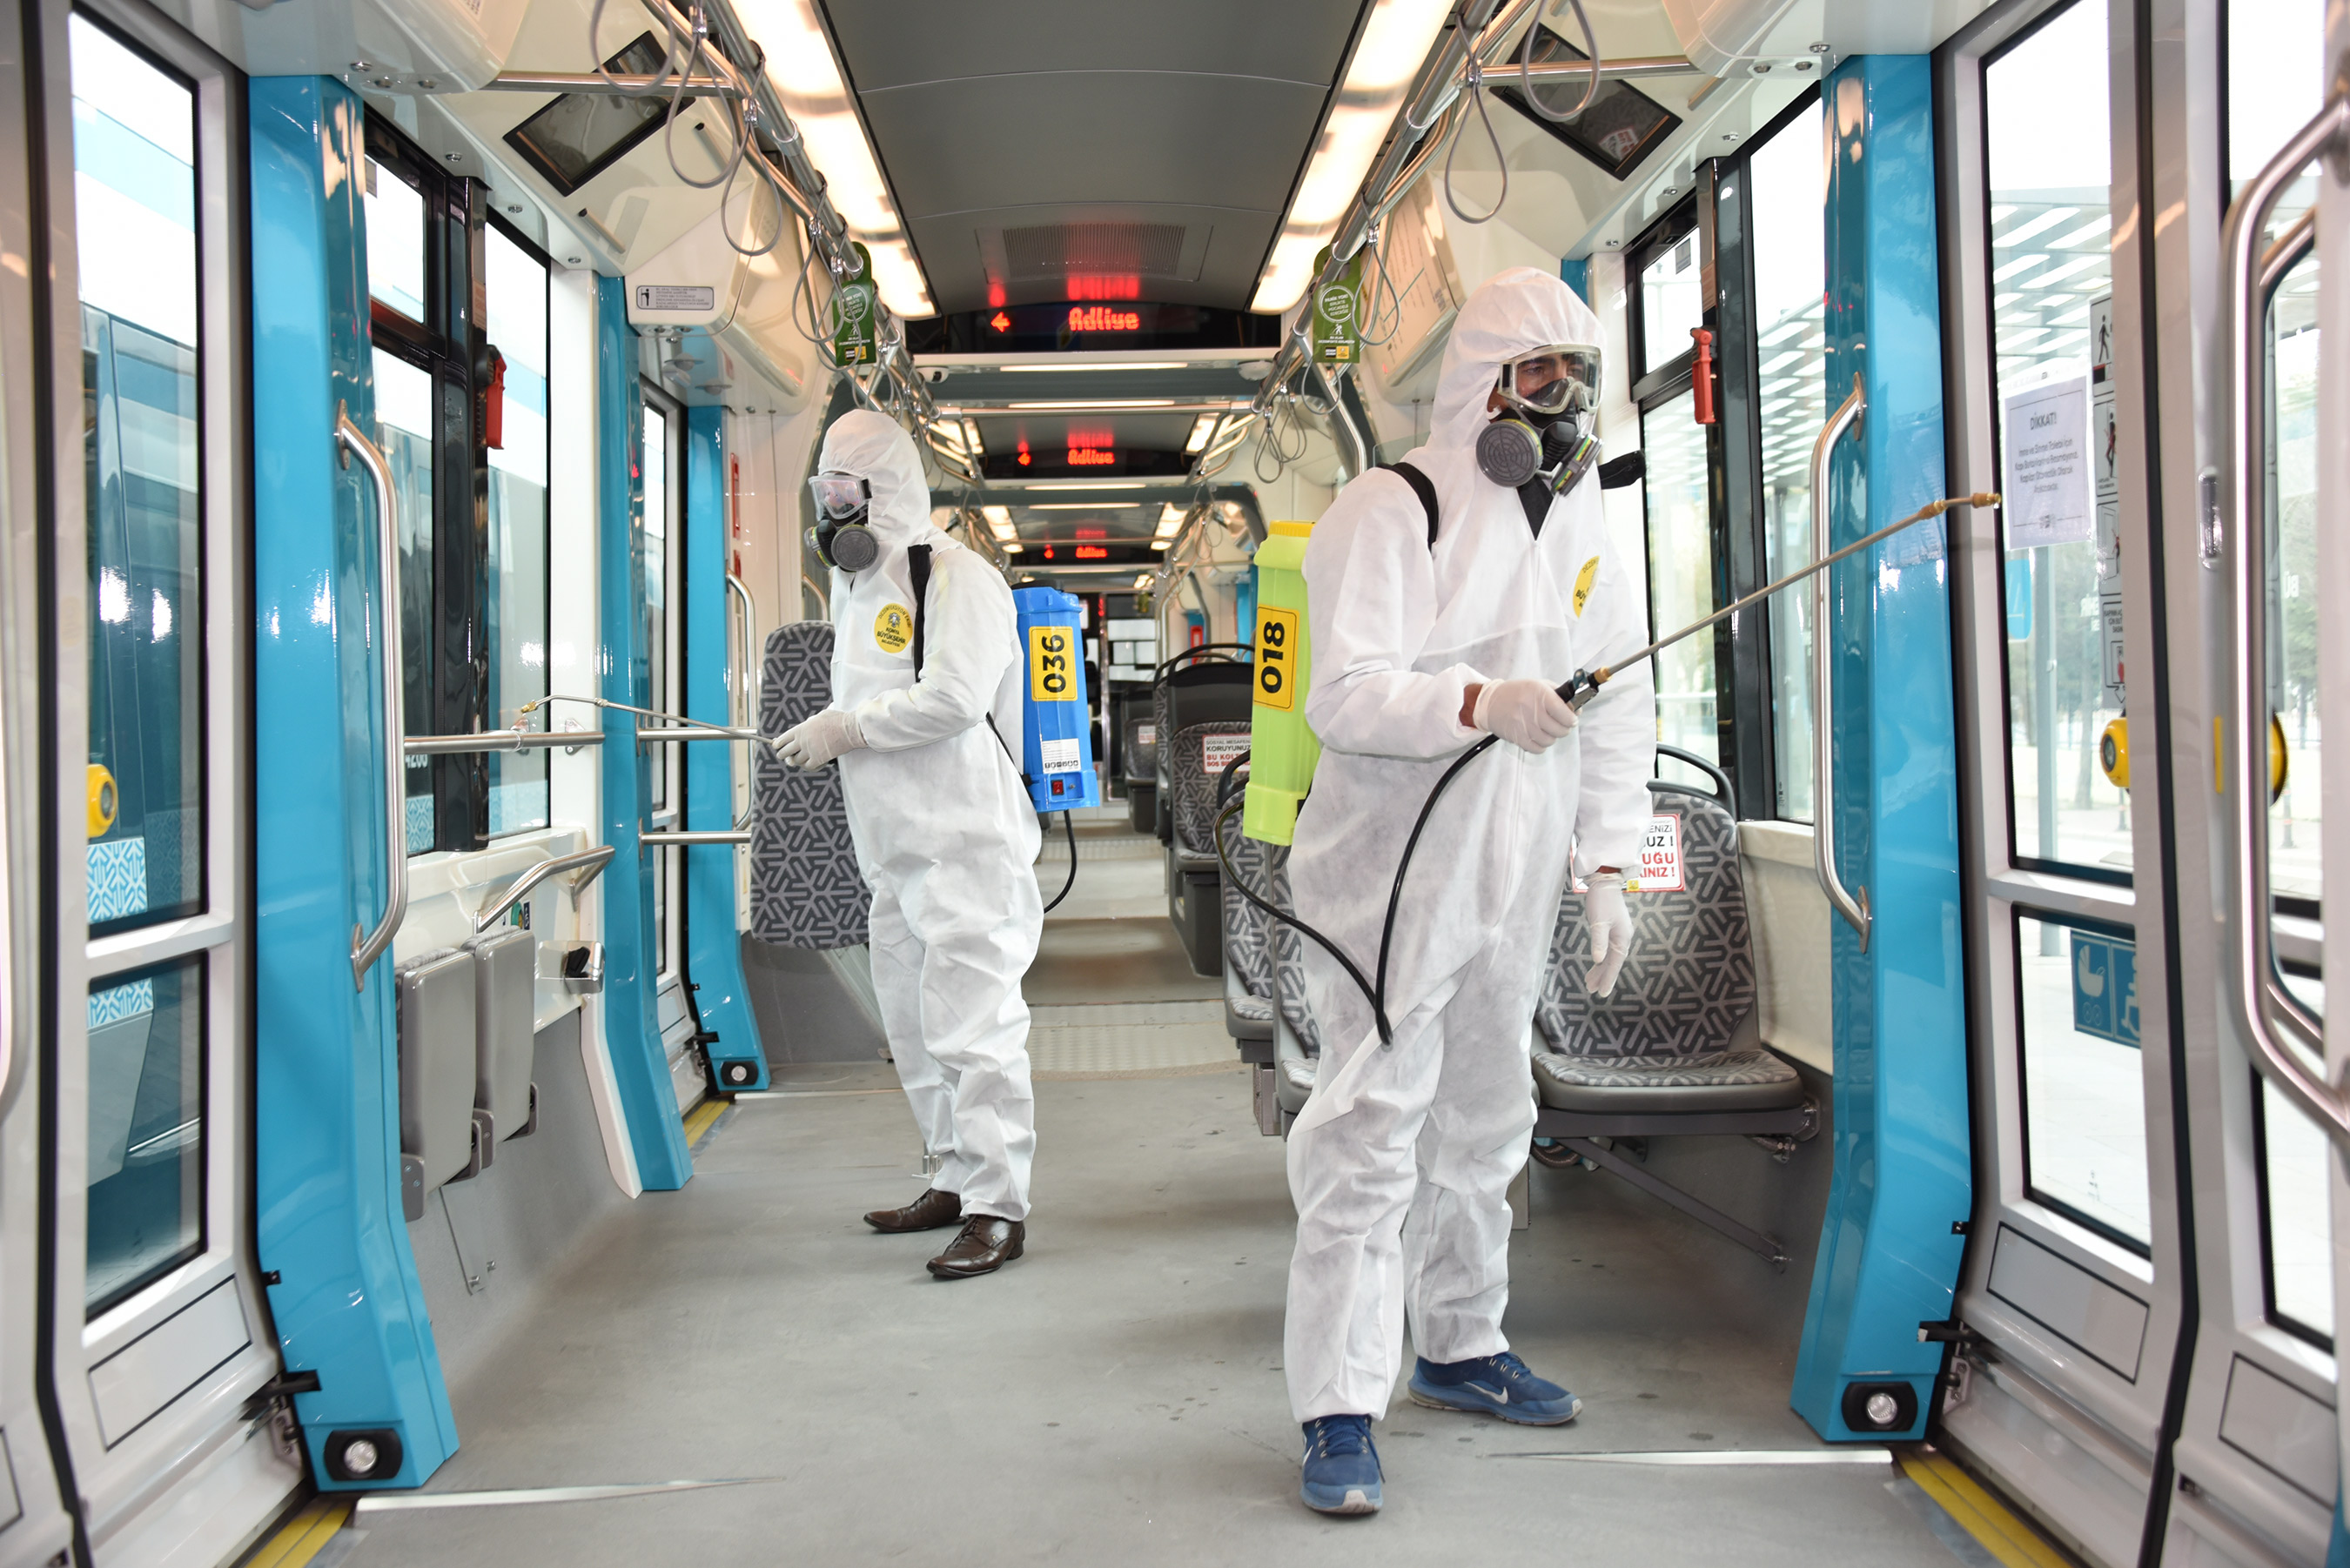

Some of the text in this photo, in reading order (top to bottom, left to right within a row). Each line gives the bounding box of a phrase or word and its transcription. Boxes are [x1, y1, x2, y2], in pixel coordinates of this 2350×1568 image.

[1069, 306, 1139, 331] Adliye
[2030, 412, 2057, 430] DİKKAT!
[1068, 448, 1115, 465] Adliye
[1041, 634, 1066, 693] 036
[1260, 621, 1285, 694] 018
[1649, 824, 1672, 833] ENİZİ
[1646, 836, 1665, 847] UZ
[1642, 851, 1675, 865] UĞU
